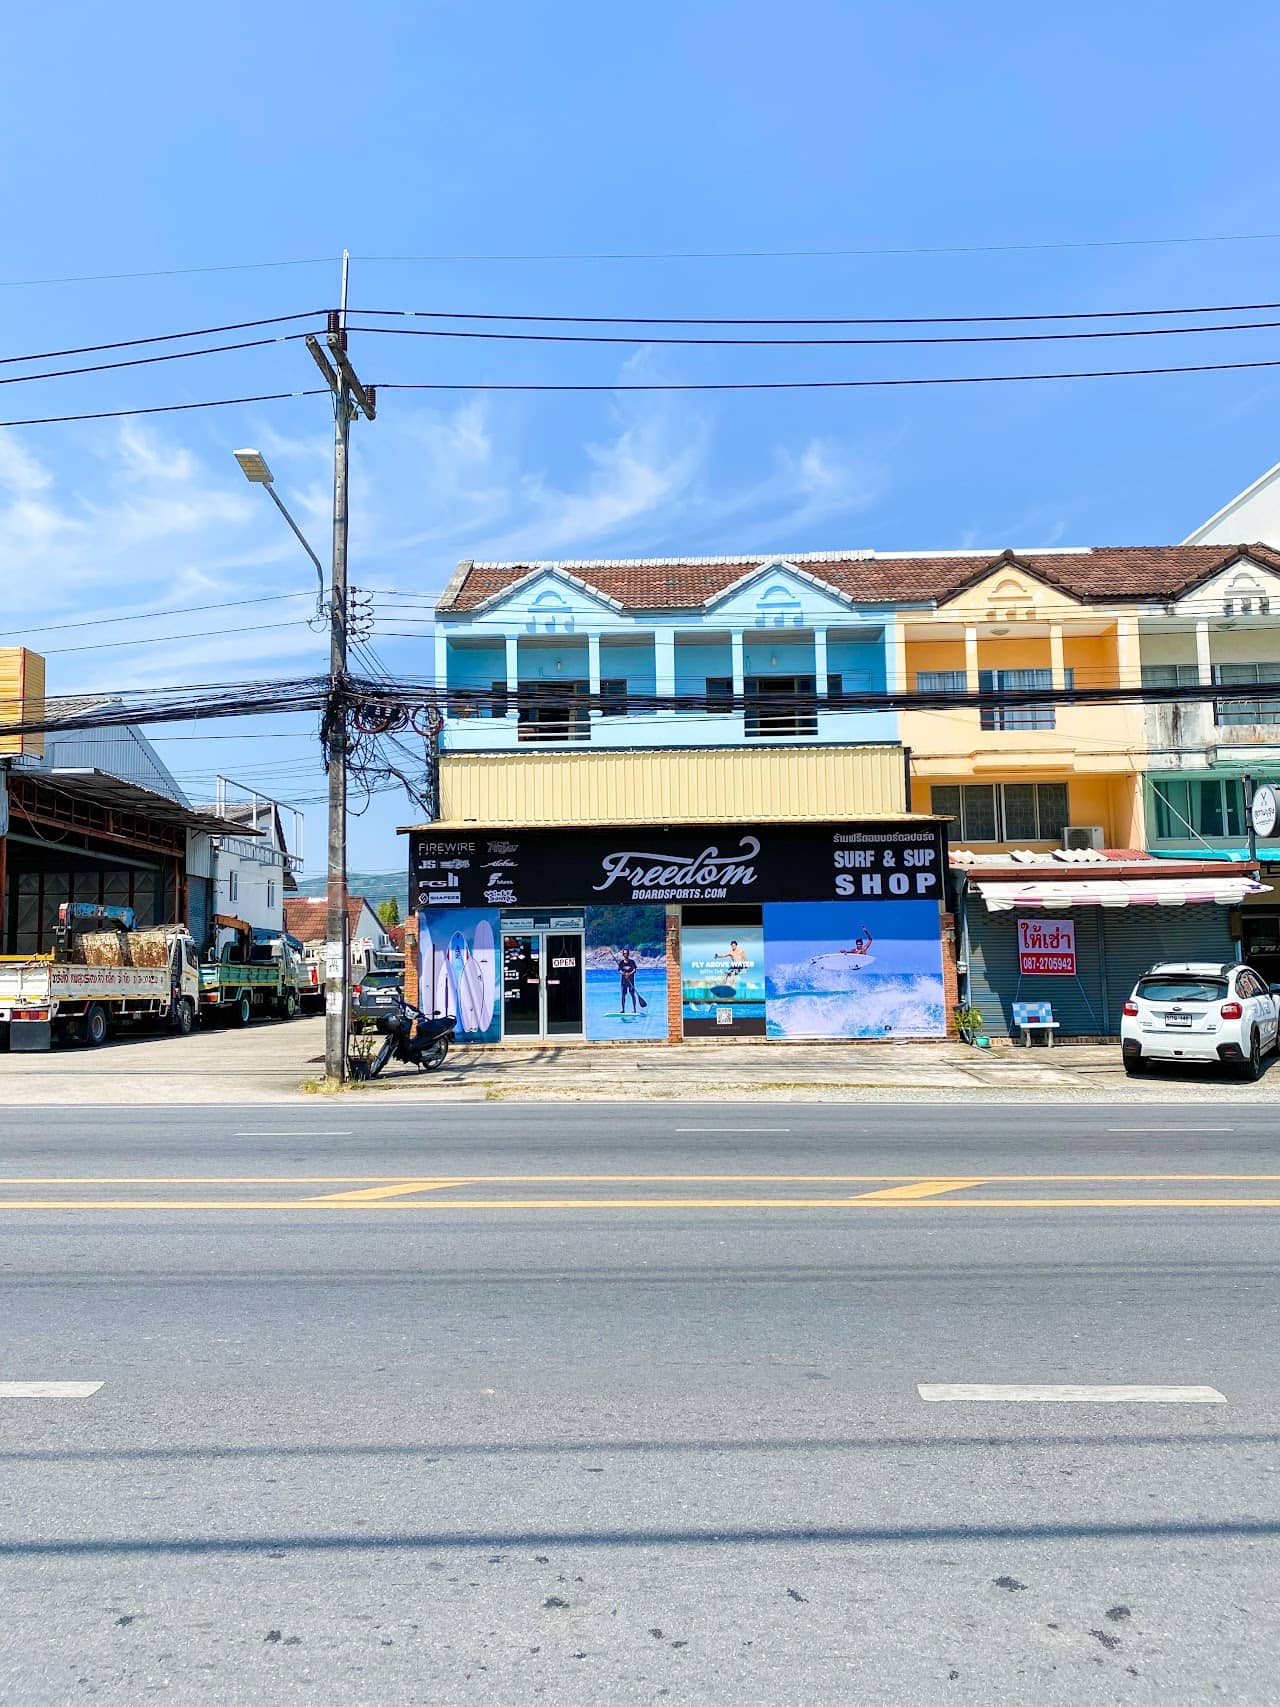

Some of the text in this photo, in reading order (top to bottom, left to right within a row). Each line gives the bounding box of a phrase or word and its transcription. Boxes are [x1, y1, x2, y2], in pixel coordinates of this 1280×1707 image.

[418, 842, 476, 852] FIREWIRE
[592, 835, 761, 891] Freedom
[833, 848, 935, 868] SURF & SUP
[834, 872, 937, 896] SHOP
[632, 887, 727, 900] BOARDSPORTS.COM
[1020, 922, 1072, 949] ให้เช่า
[553, 958, 575, 967] OPEN
[730, 960, 755, 968] WATER
